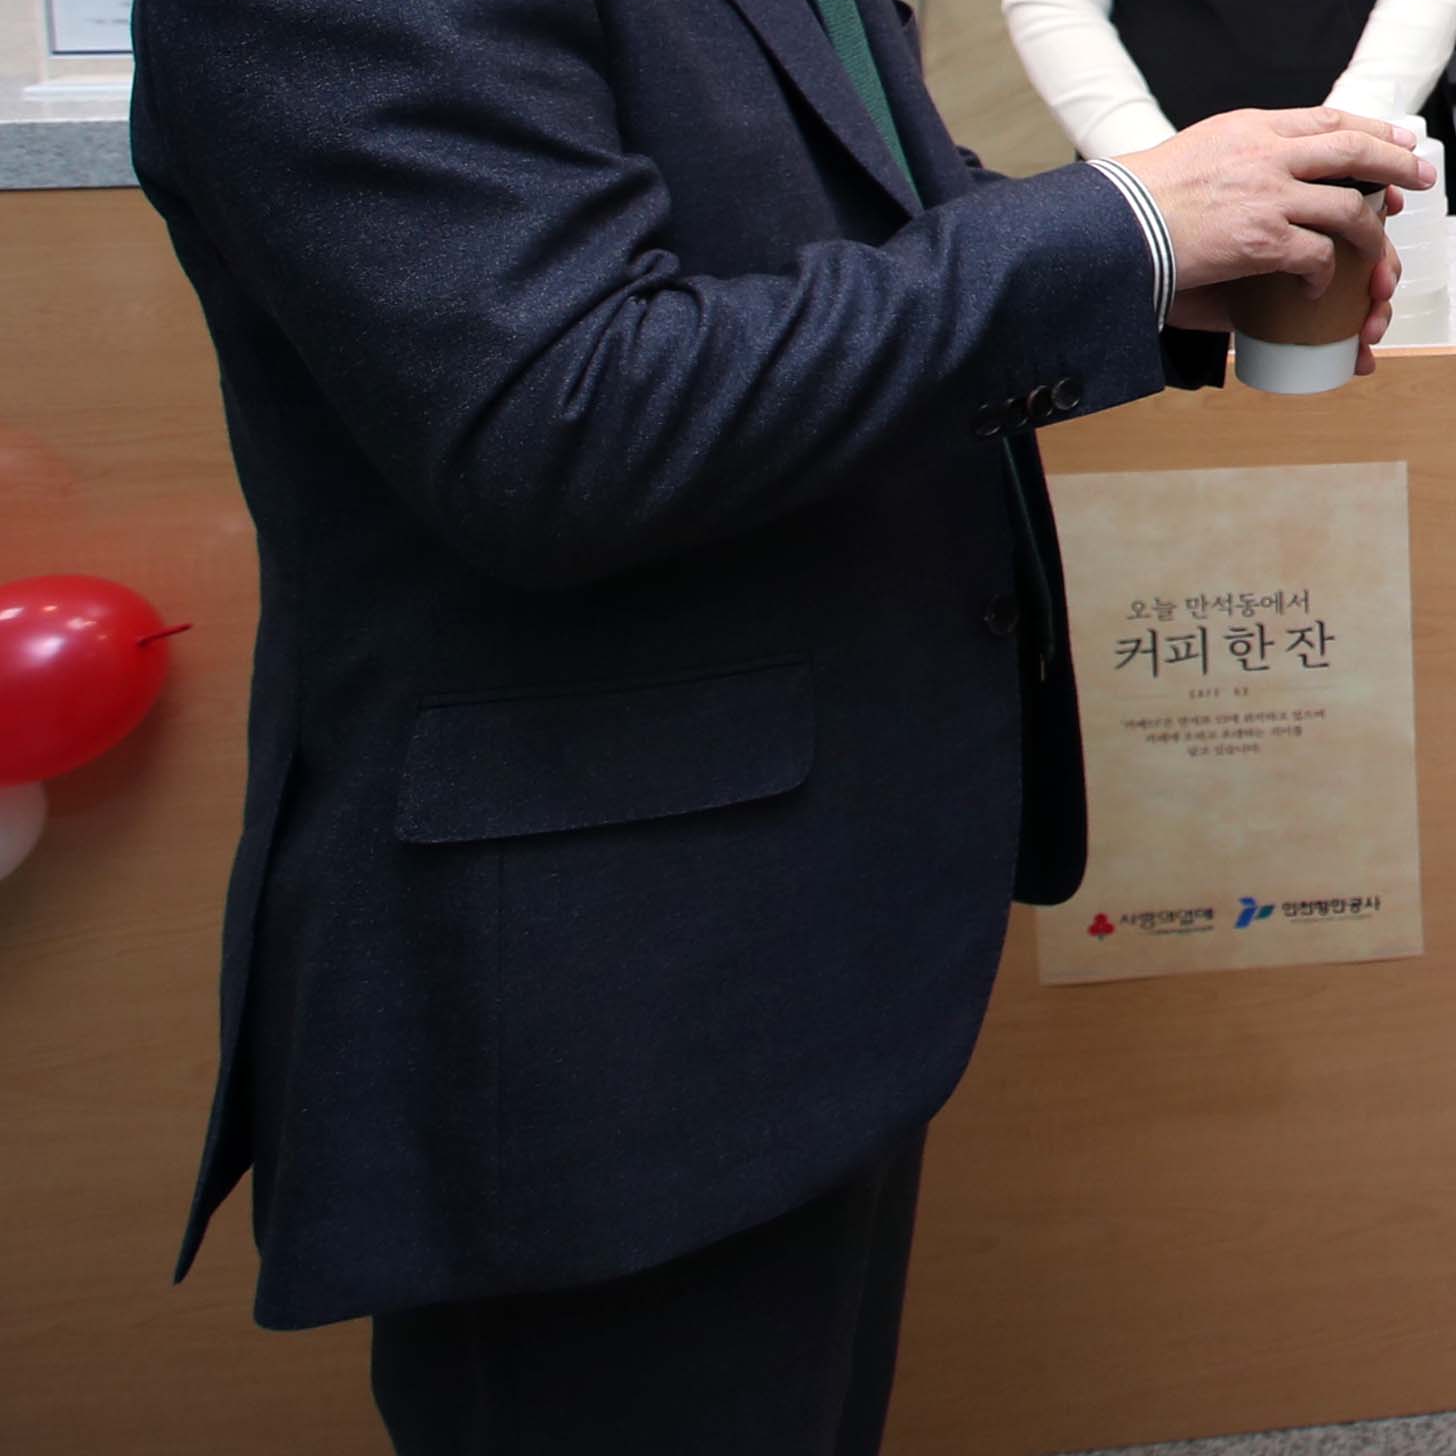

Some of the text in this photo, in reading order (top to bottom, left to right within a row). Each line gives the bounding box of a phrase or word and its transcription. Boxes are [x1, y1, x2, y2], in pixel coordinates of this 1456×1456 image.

[1126, 589, 1311, 621] 오늘 만석동에서
[1115, 619, 1335, 678] 커피 한 잔
